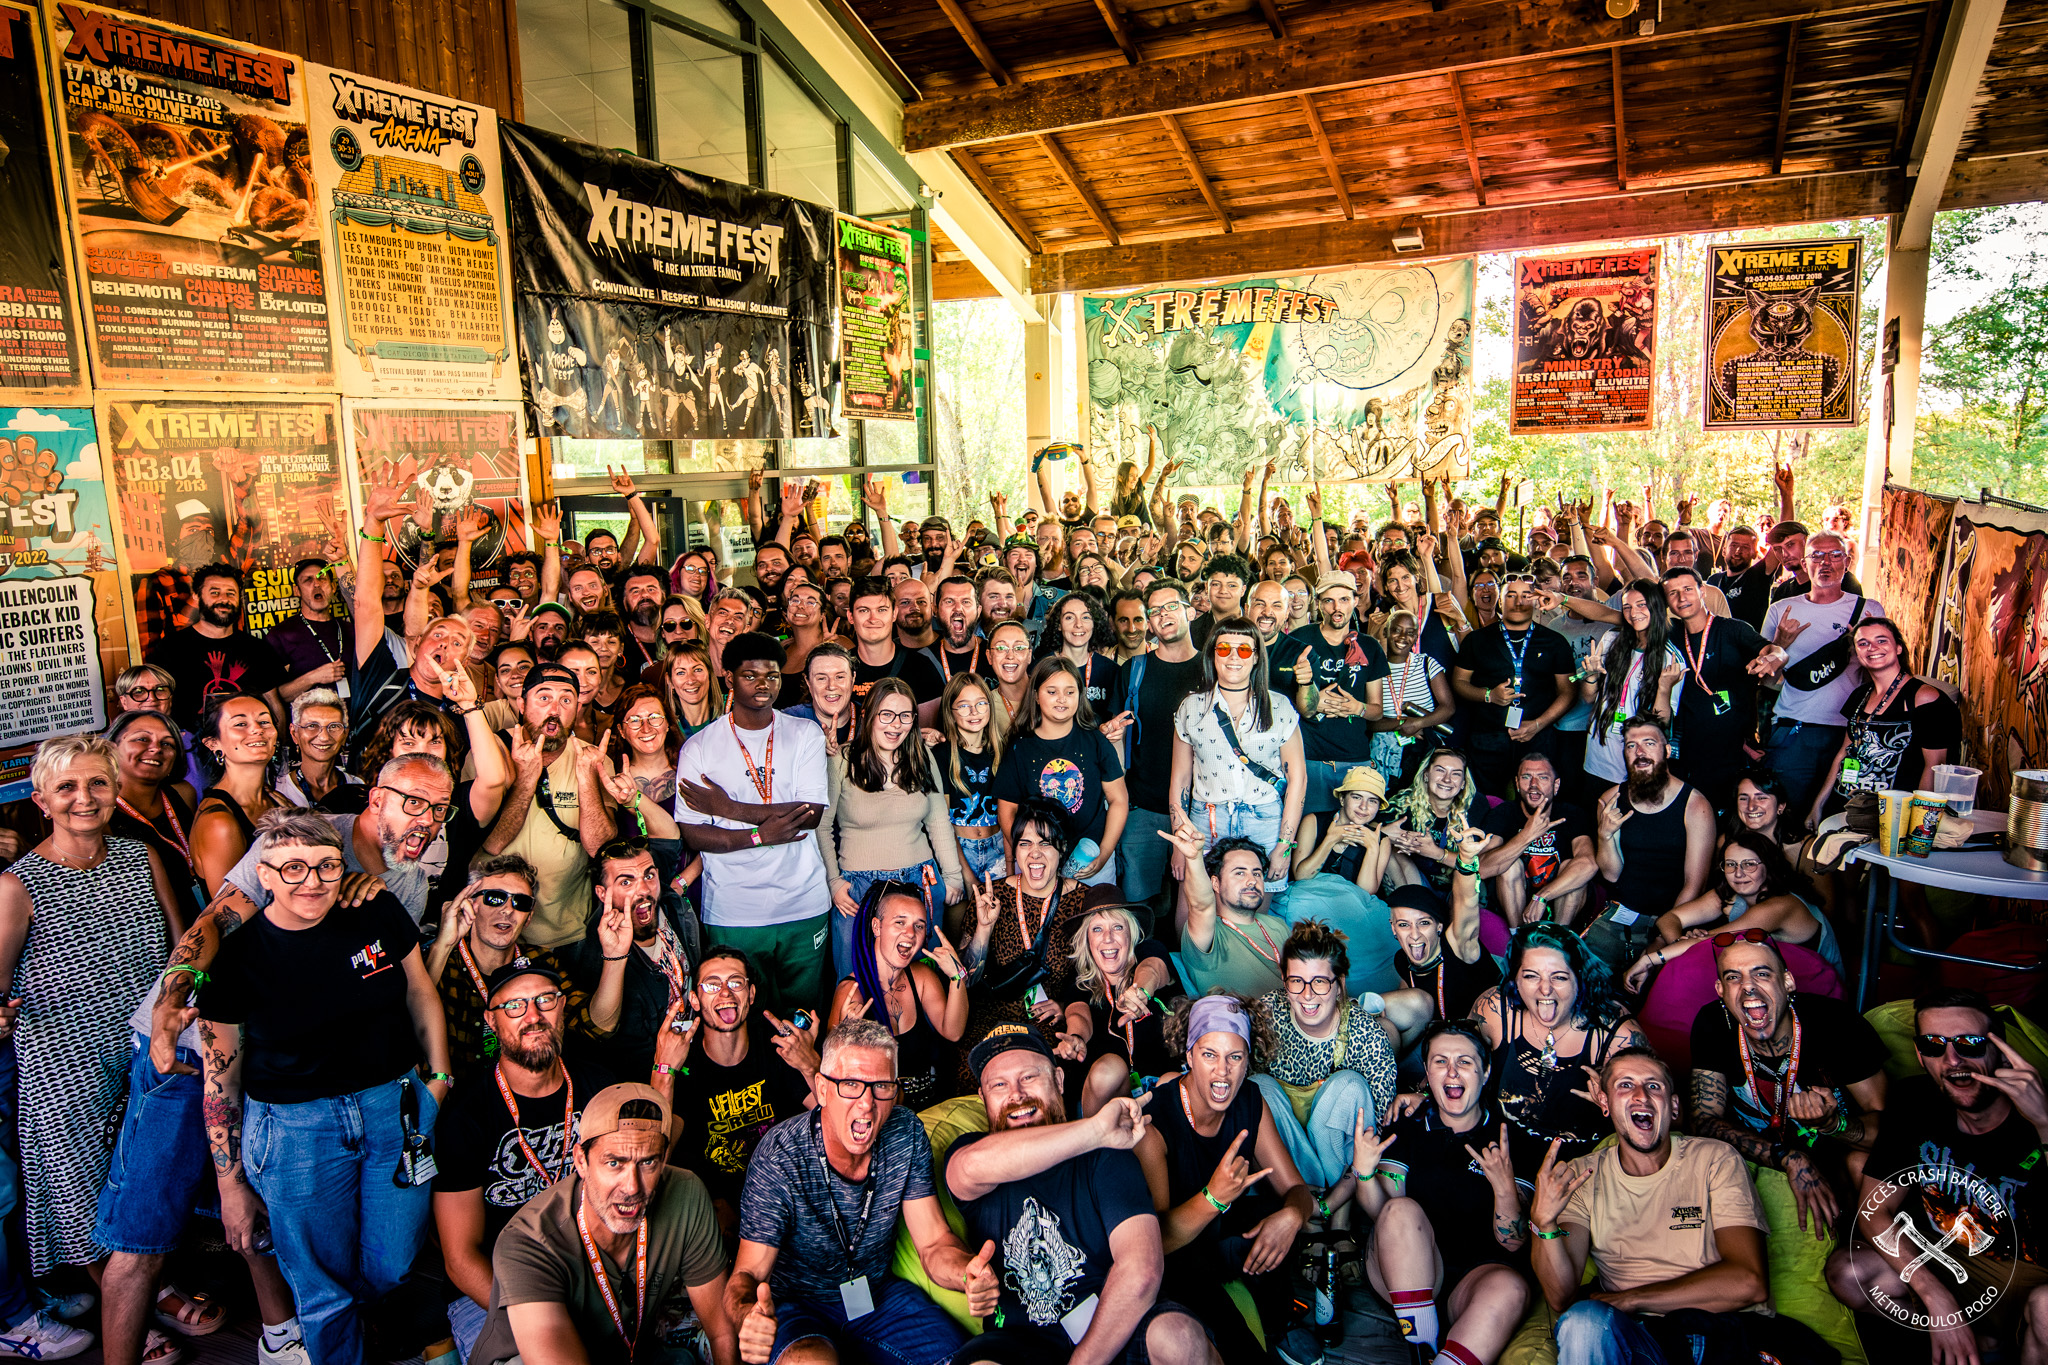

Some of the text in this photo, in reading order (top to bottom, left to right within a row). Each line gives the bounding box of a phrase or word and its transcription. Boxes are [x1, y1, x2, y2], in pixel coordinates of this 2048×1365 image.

[57, 2, 213, 74] XTREME
[215, 51, 292, 100] FEST
[67, 80, 223, 125] CAP DECOUVERTE
[143, 85, 192, 104] JUILLET
[196, 96, 221, 111] 2015
[330, 75, 478, 142] XTREME FEST
[68, 95, 185, 125] ALBI CARMAUX FRANCE
[371, 115, 450, 155] ARENA
[583, 182, 784, 285] XTREME FEST
[838, 219, 884, 252] XTREME
[884, 238, 908, 264] FEST
[87, 247, 124, 260] BLACK
[342, 231, 493, 260] LES TAMBOURS DU BRONX ULTRA VOMIT
[344, 242, 494, 270] LES SHERIFF BURNING HEADS
[88, 257, 171, 280] SOCIETY
[652, 258, 742, 282] WE ARE AN XTREME FAMILY
[1522, 250, 1656, 284] XTREME FEST
[1716, 244, 1855, 276] XTREME FEST
[1764, 266, 1794, 274] VOLTAGE
[172, 261, 322, 296] ENSIFERUM SATANIC SURFERS
[1768, 280, 1815, 288] DECOUVERTE
[91, 278, 256, 310] BEHEMOTH CANNIBAL CORPSE
[258, 292, 326, 314] THE EXPLOITED
[592, 278, 788, 317] CONVIVIALITE RESPECT INCLUSION SOLIDARITE
[124, 306, 176, 317] COMEBACK
[178, 310, 194, 318] KID
[240, 315, 278, 324] SECONDS
[22, 340, 67, 350] FREIHEIT
[9, 364, 70, 372] TERROR SHARK
[546, 350, 576, 370] XTREME
[1544, 358, 1624, 372] MINISTRY
[553, 370, 574, 380] FEST
[1516, 377, 1650, 390] NAPALM DEATH ELUVEITIE
[1518, 368, 1650, 382] TESTAMENT EXODUS
[112, 403, 333, 450] XTREME FEST
[358, 411, 514, 452] XTREME FEST
[260, 454, 330, 464] CAP DECOUVERTE
[261, 463, 330, 474] ALBI CARMAUX
[128, 479, 206, 494] AOUT 2013
[282, 472, 319, 483] FRANCE
[14, 551, 48, 565] 2022
[0, 605, 80, 630] EBACK KID
[19, 624, 84, 647] SURFERS
[8, 642, 86, 662] THE FLATLINERS
[38, 658, 62, 671] DEVIL
[64, 656, 73, 667] IN
[75, 654, 87, 665] ME
[2, 679, 90, 700] GRADE WAR ON WOMEN
[12, 668, 89, 688] POWER DIRECT HIT!
[8, 689, 92, 710] COPYRIGHTS BLOWFUSE
[2, 756, 30, 769] TARN
[504, 1092, 516, 1113] DU TARN
[708, 1079, 766, 1121] HELLFEST
[708, 1104, 775, 1135] CREW
[584, 1235, 597, 1260] DU TARN
[598, 1274, 624, 1334] DÉPARTEMENT DU TARN
